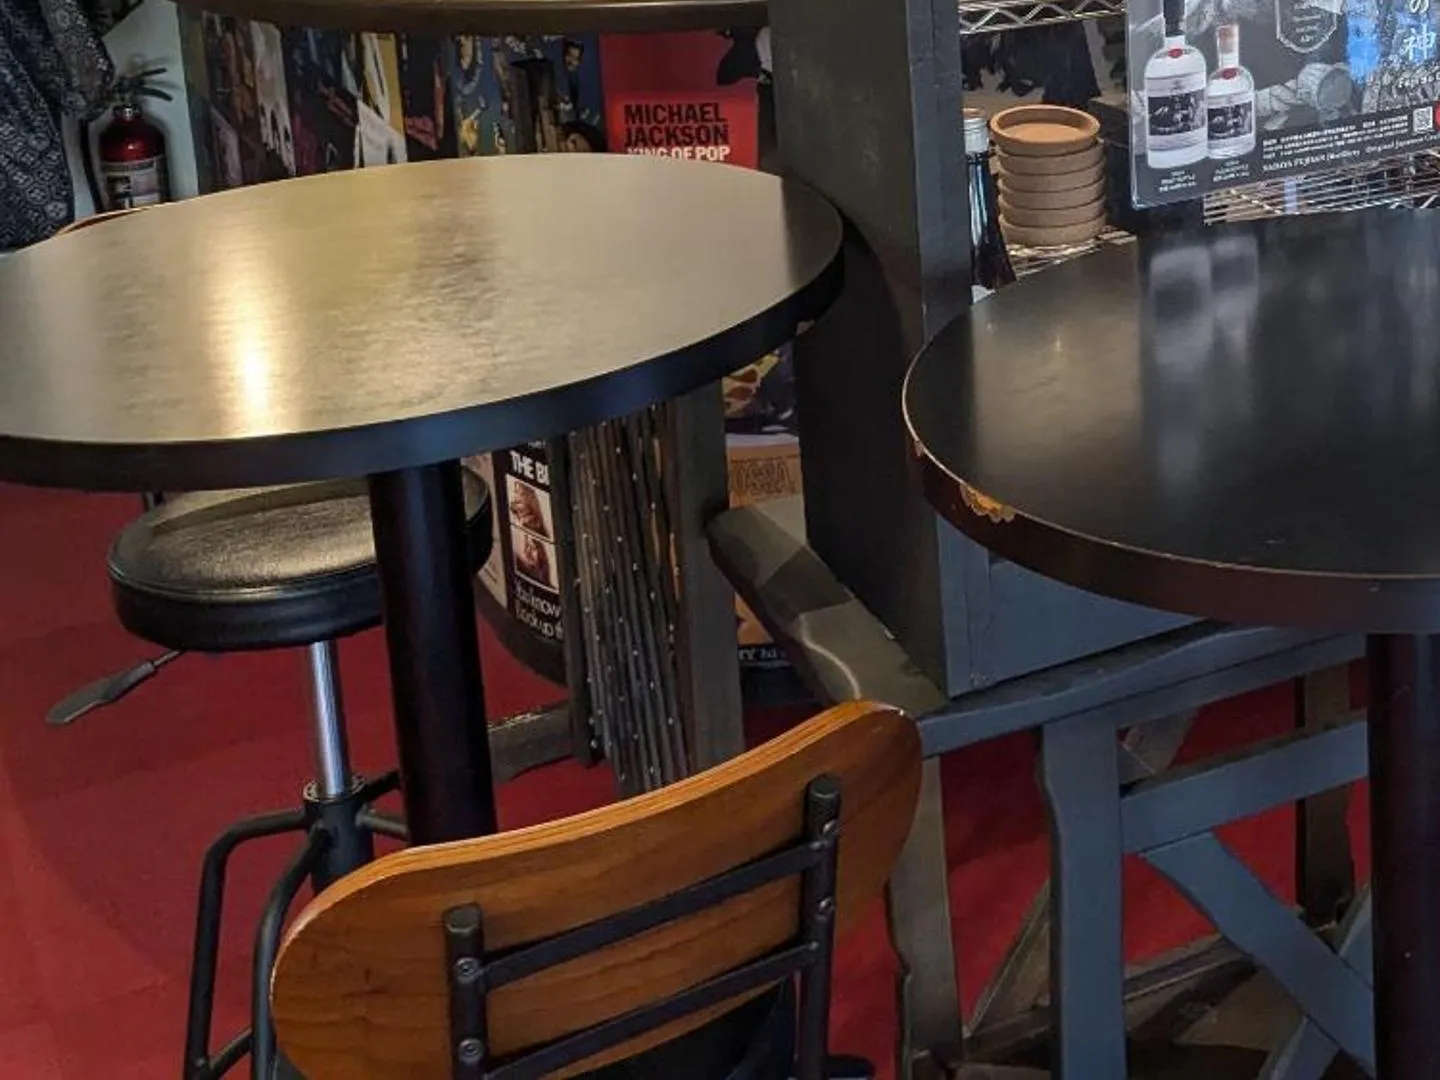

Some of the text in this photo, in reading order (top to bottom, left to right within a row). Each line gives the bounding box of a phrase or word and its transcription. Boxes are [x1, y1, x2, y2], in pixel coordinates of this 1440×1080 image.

[624, 103, 728, 125] MICHAEL
[624, 123, 730, 147] JACKSON
[695, 145, 731, 162] POP
